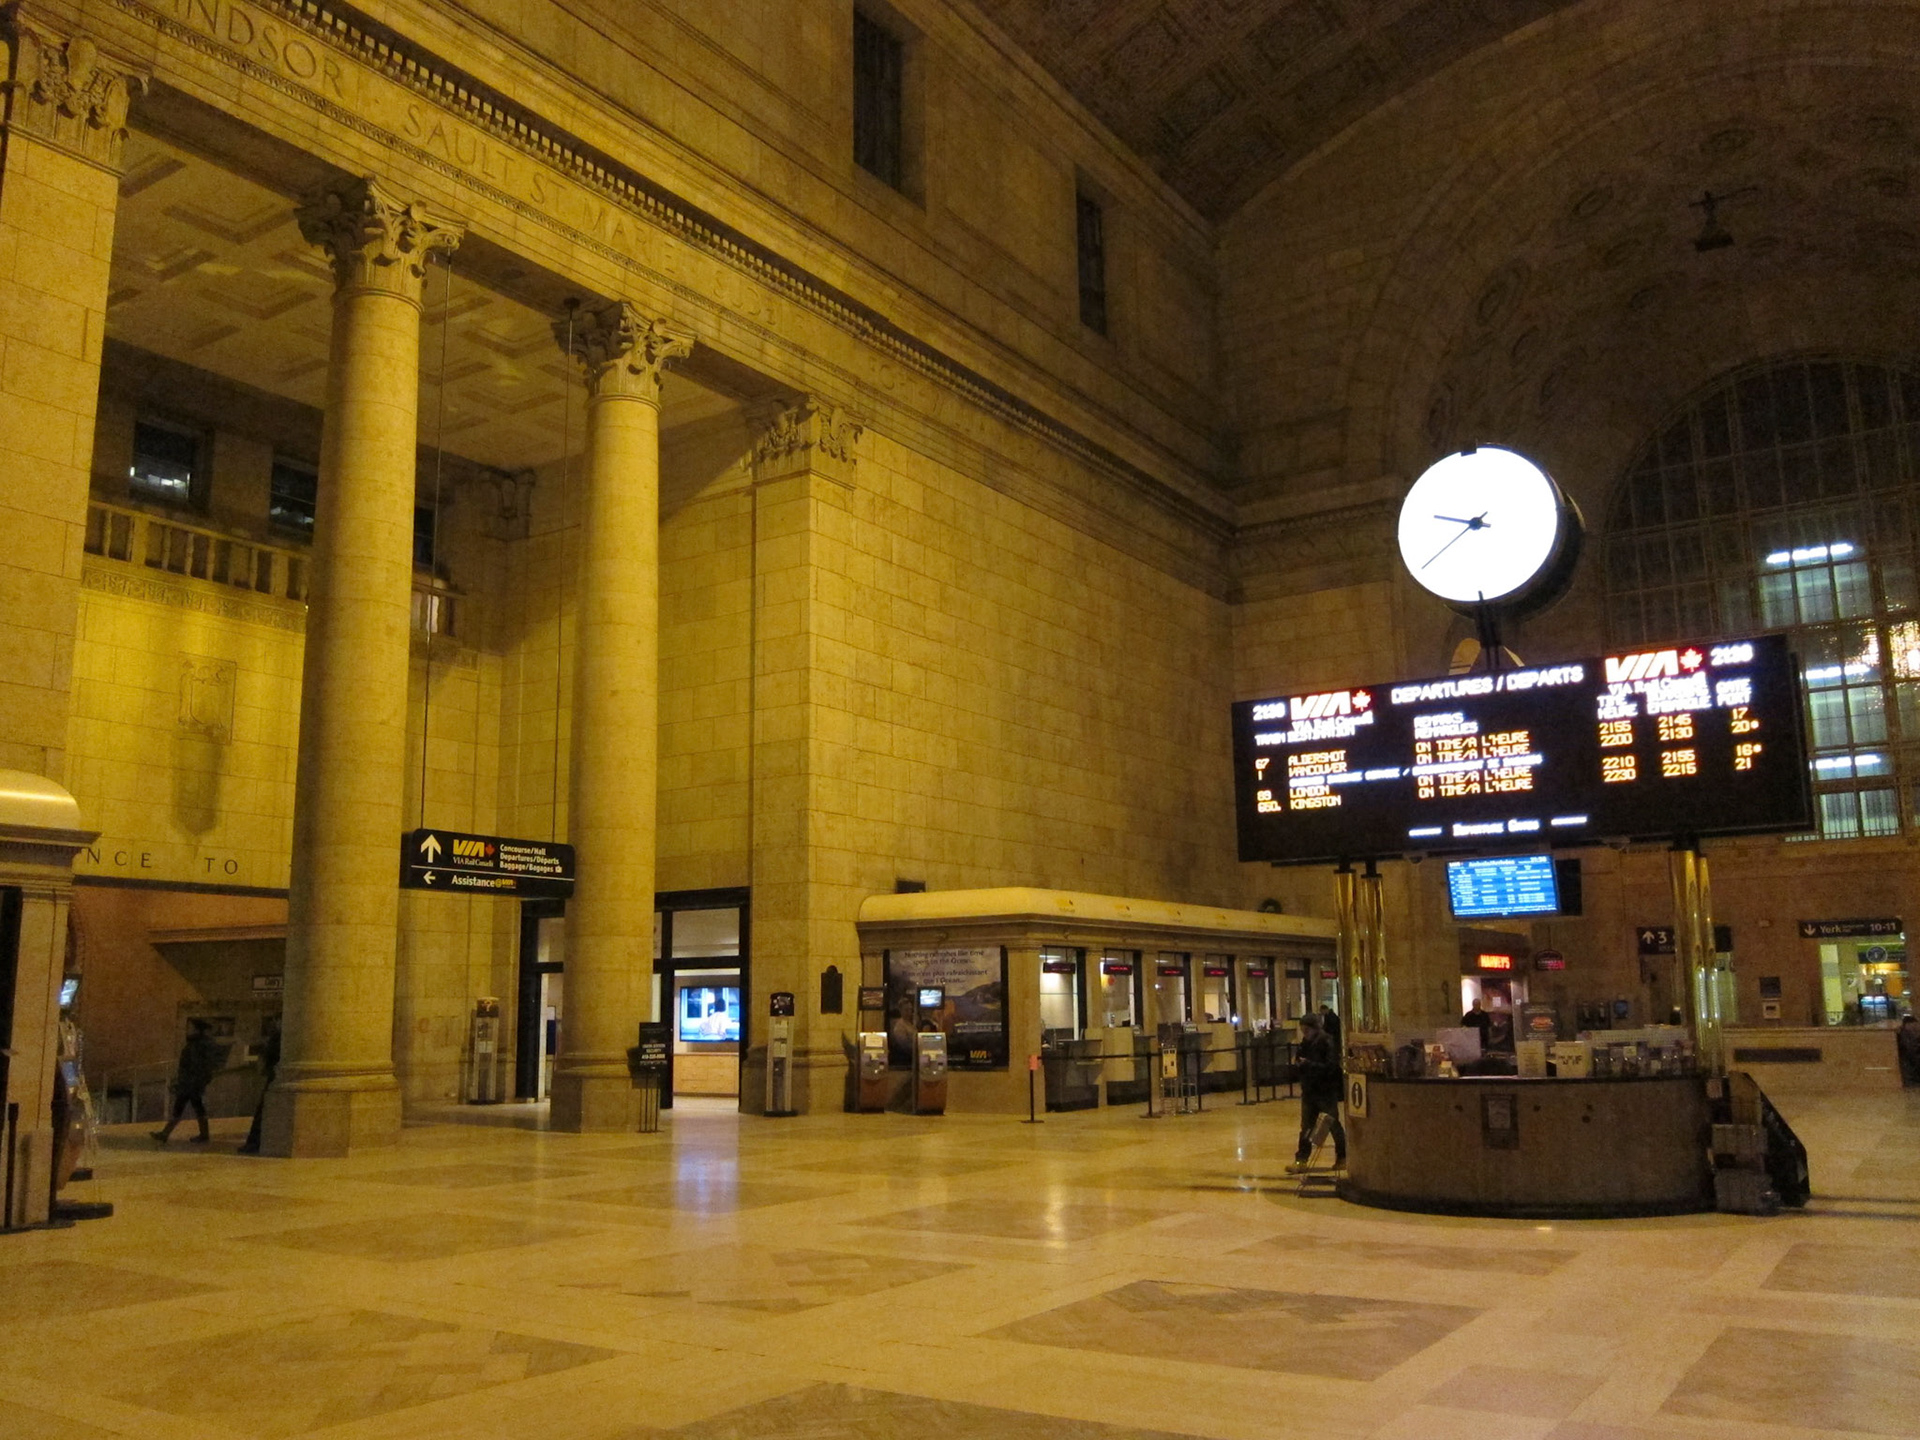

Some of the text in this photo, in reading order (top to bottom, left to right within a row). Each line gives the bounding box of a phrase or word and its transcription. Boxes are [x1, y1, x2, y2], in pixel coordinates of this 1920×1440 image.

[172, 0, 347, 99] INDSOR
[1605, 650, 1678, 683] VIA
[1391, 677, 1493, 704] DEPARTURES
[1506, 666, 1584, 690] DEPARTS
[1290, 691, 1351, 720] VIA
[1732, 707, 1748, 720] 17
[1600, 720, 1631, 734] 2155
[1659, 726, 1692, 741] 2130
[1731, 720, 1750, 734] 20
[1415, 741, 1431, 753] ON
[1601, 732, 1633, 747] 2200
[1288, 750, 1346, 767] ALDERSHOT
[1416, 753, 1432, 765] ON
[1602, 755, 1635, 770] 2210
[1735, 757, 1752, 771] 21
[1289, 762, 1347, 777] VANCOUVER
[1604, 768, 1636, 783] 2230
[1663, 762, 1697, 777] 2215
[1418, 774, 1434, 787] ON
[1290, 784, 1330, 798] LONDON
[1418, 786, 1434, 799] ON
[1290, 795, 1342, 810] KINGSTON
[453, 839, 485, 858] VIA
[87, 848, 239, 876] NCE TO
[452, 875, 495, 888] Assistance
[1820, 923, 1842, 934] York
[1870, 922, 1897, 931] 10-11
[1657, 931, 1668, 944] 3
